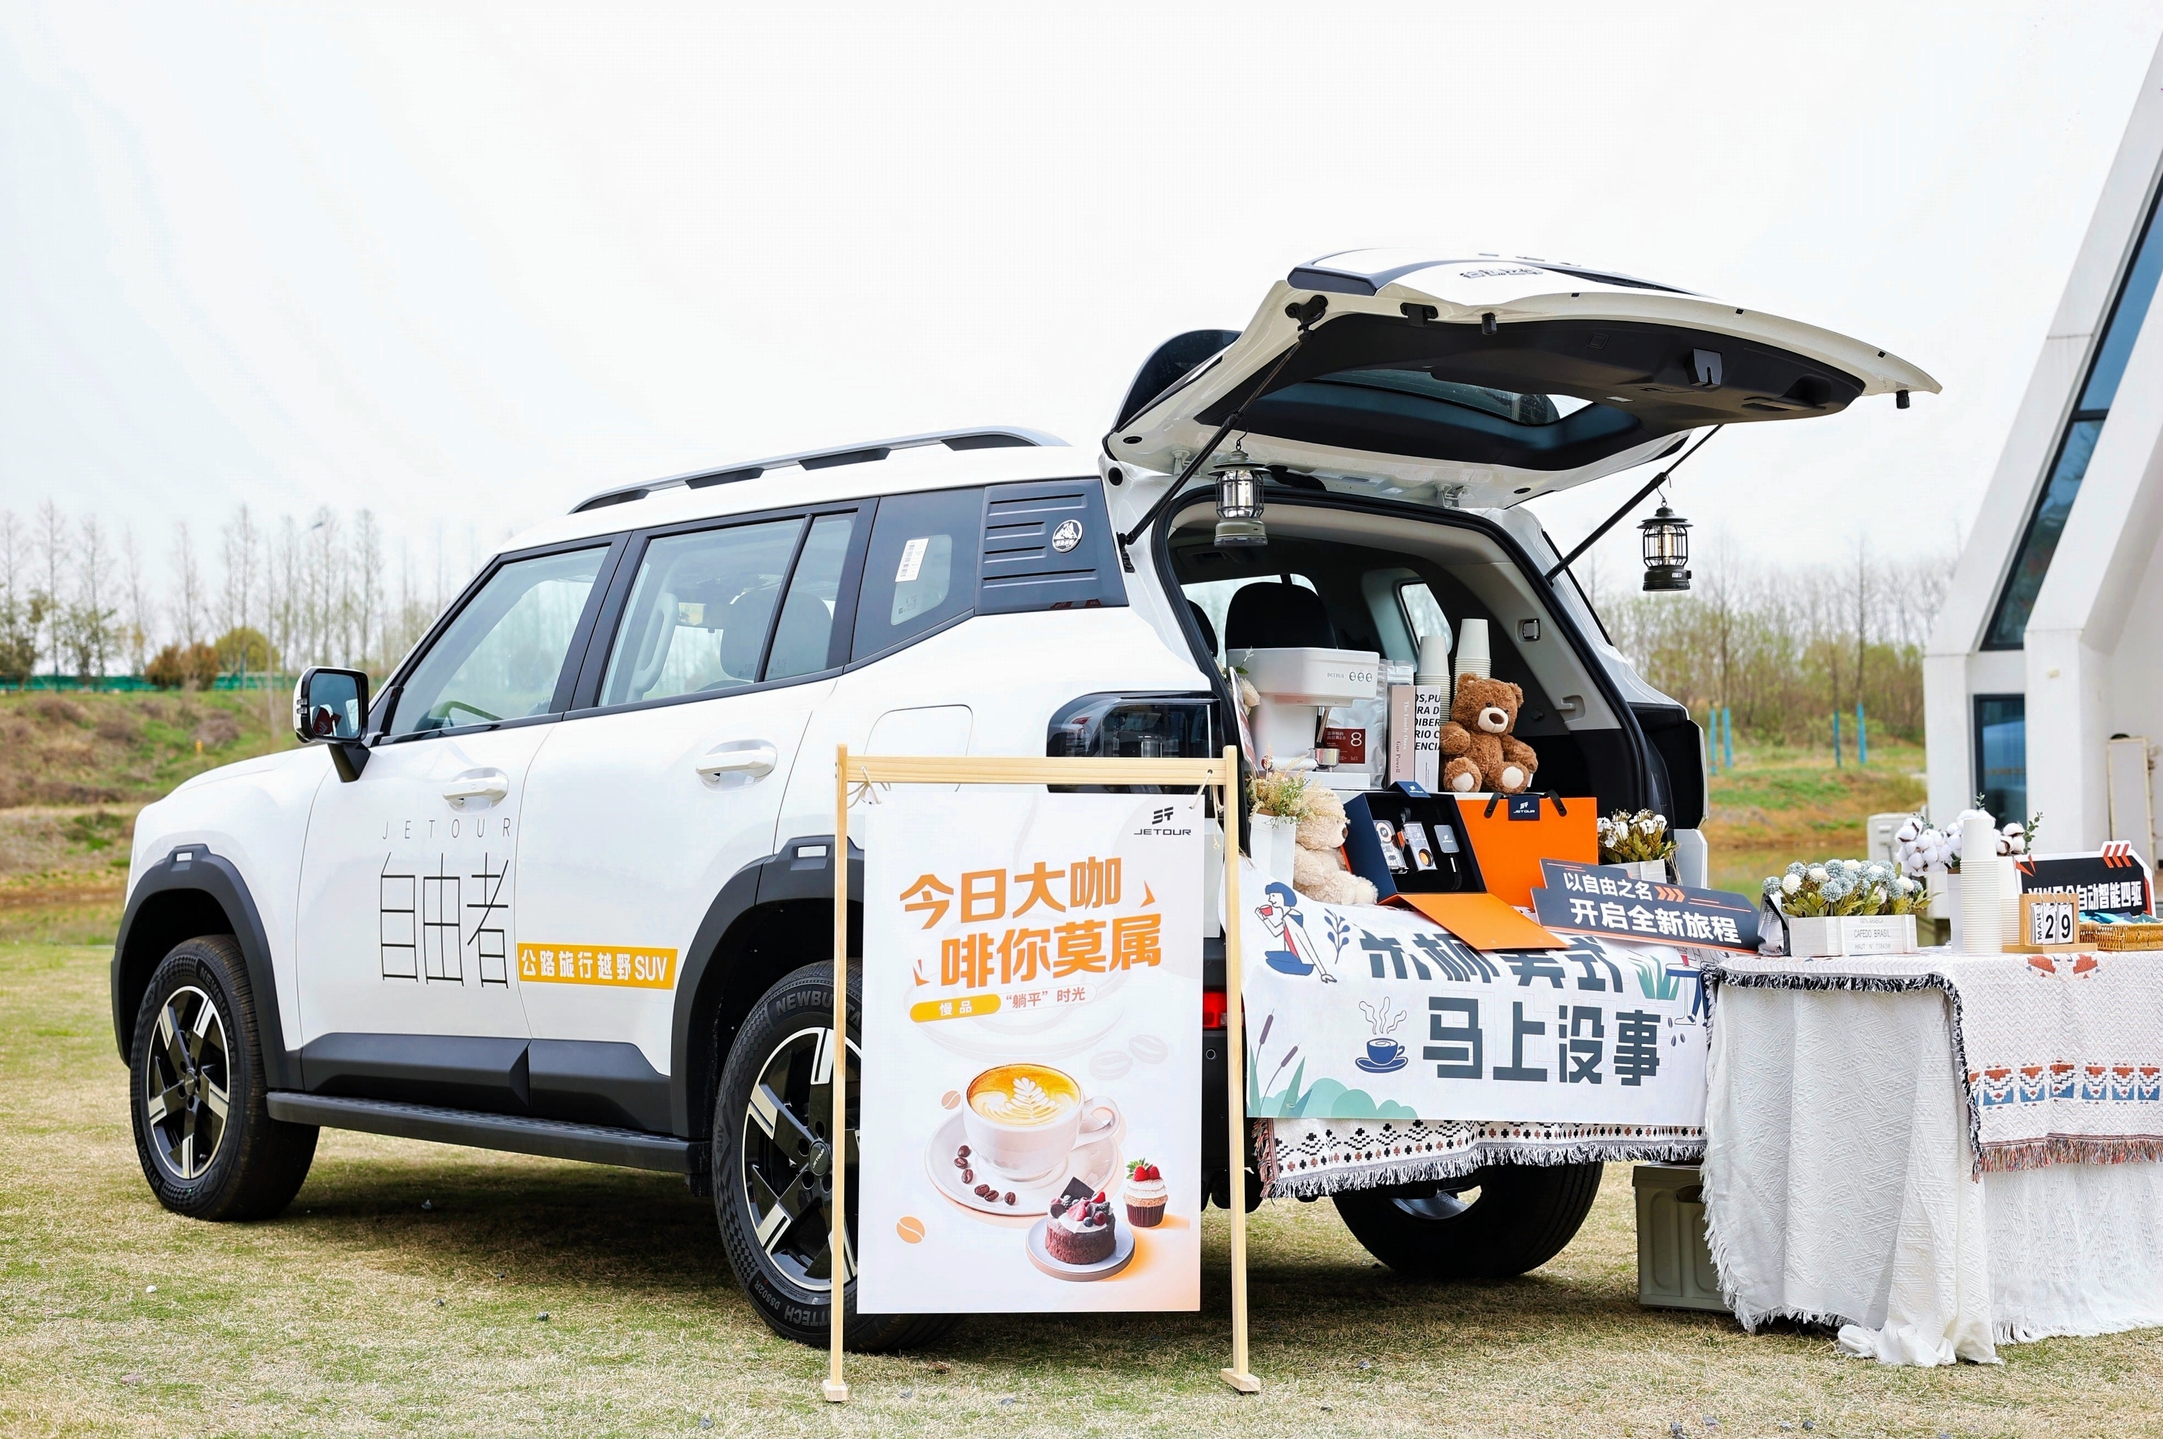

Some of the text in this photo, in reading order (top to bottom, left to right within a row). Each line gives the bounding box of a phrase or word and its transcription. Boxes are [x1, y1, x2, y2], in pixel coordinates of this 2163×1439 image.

[1350, 731, 1362, 747] 8
[382, 817, 511, 840] JETOUR
[1134, 828, 1191, 836] JETOUR
[900, 856, 1121, 930] 今日大咖
[1563, 872, 1654, 901] 以自由之名
[380, 851, 509, 989] 自由者
[1569, 898, 1742, 944] 开启全新旅程
[521, 948, 668, 982] 公路旅行越野SUV
[940, 913, 1161, 989] 啡你莫属
[1056, 987, 1086, 1003] 时光
[1423, 996, 1660, 1087] 马上没事
[784, 1304, 831, 1327] TTECH
